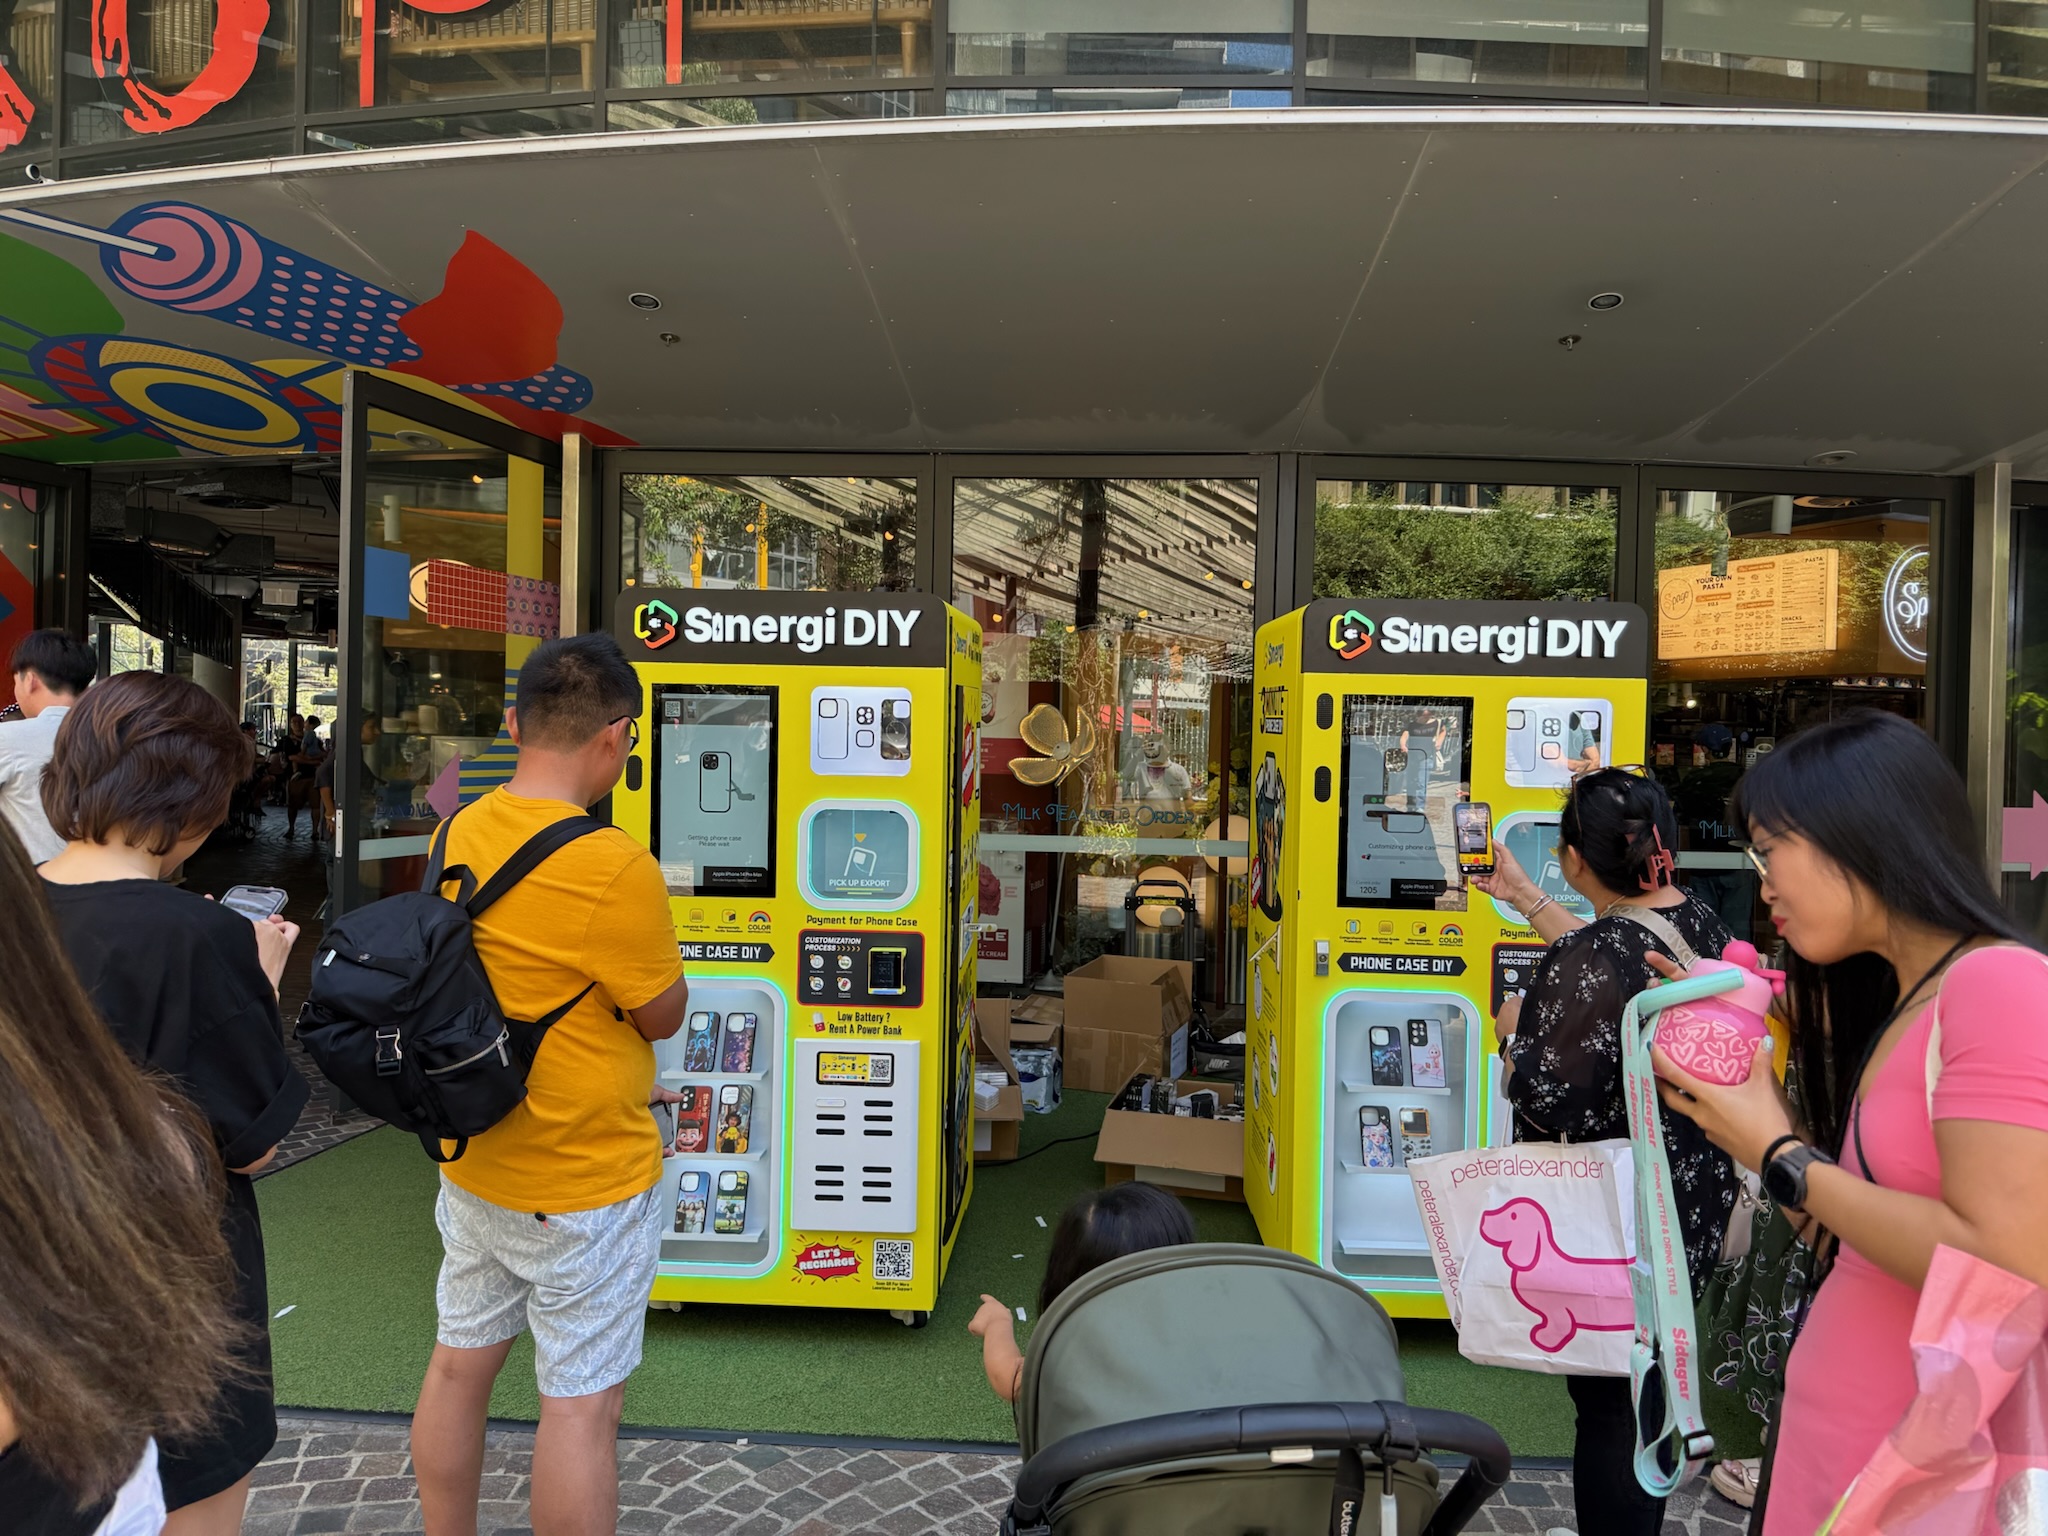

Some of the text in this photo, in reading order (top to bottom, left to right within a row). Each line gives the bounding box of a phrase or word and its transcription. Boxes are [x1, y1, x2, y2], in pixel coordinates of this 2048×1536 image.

[1702, 583, 1724, 591] PASTA
[684, 606, 836, 653] Sinergi
[843, 609, 922, 647] DIY
[1380, 615, 1628, 664] Sinergi DIY
[687, 834, 709, 843] Getting
[710, 835, 727, 843] phone
[1368, 843, 1403, 851] Customizing
[1405, 843, 1423, 851] phone
[829, 879, 847, 887] PICK
[1360, 886, 1378, 894] 1205
[1554, 894, 1585, 902] EXPORT
[806, 915, 918, 926] Payment for Phone Case
[804, 936, 861, 944] CUSTOMIZATION
[1500, 928, 1537, 939] Paymen
[678, 944, 761, 959] ONE CASE DIY
[1498, 950, 1547, 958] CUSTOMIZAT
[1350, 956, 1453, 973] PHONE CASE DIY
[1498, 958, 1531, 966] PROCESS
[837, 1011, 853, 1021] Low
[855, 1012, 884, 1024] Battery
[829, 1023, 902, 1035] Rent A Power Bank
[1208, 1059, 1230, 1069] NIKE
[1628, 1072, 1639, 1141] Sidagar
[1641, 1077, 1657, 1148] Sidagar
[1450, 1154, 1604, 1188] peteralexander
[1653, 1162, 1662, 1190] DRINK
[1656, 1192, 1668, 1226] BETTER
[811, 1248, 842, 1260] LET'S
[1663, 1236, 1673, 1265] DRINK
[799, 1257, 856, 1270] RECHARGE
[1667, 1267, 1678, 1296] STYLE
[1672, 1328, 1690, 1401] Sidagar
[1340, 1500, 1355, 1536] butte
